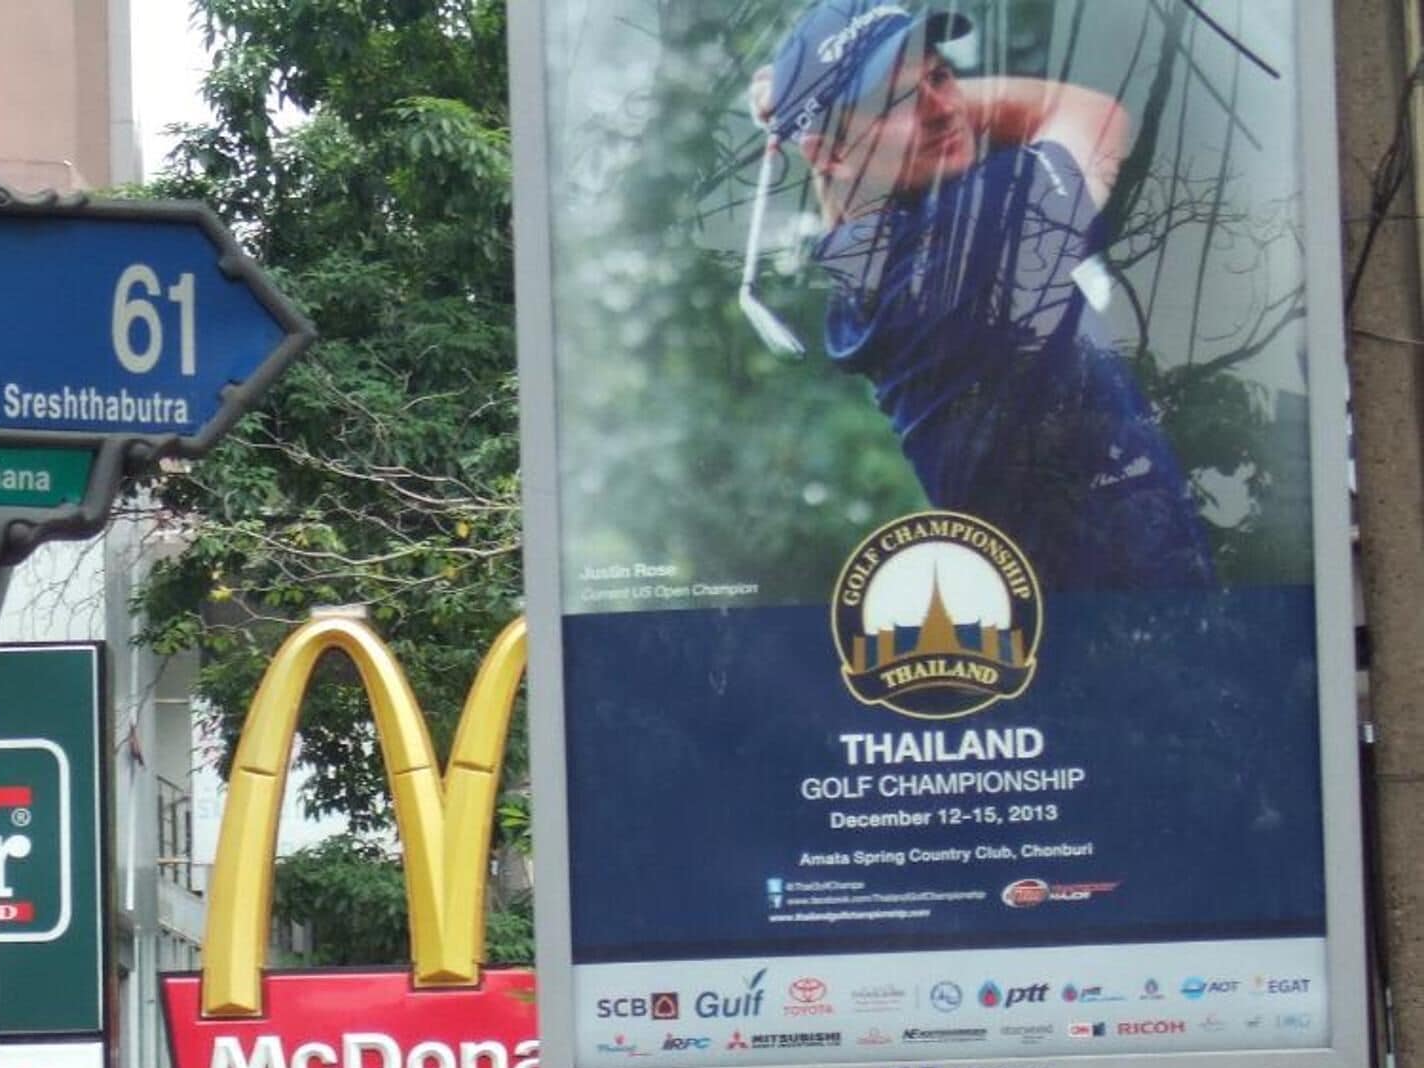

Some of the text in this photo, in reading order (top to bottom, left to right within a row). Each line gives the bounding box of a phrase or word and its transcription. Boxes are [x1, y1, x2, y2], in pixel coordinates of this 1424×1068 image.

[111, 263, 197, 376] 61
[4, 387, 189, 424] Sreshthabutra
[842, 519, 1032, 608] GOLF CHAMPIONSHIP
[880, 659, 1000, 688] THAILAND
[839, 727, 1045, 766] THAILAND
[801, 767, 1086, 801] GOLF CHAMPIONSHIP
[830, 804, 1058, 829] December 12-15, 2013
[800, 853, 850, 868] Amata
[854, 850, 905, 868] Spring
[909, 847, 971, 866] Country
[1004, 983, 1049, 1009] ptt
[1268, 978, 1311, 994] EGAT
[596, 998, 648, 1019] SCB
[783, 1004, 834, 1017] TOYOTA
[1117, 1021, 1185, 1035] RICOH
